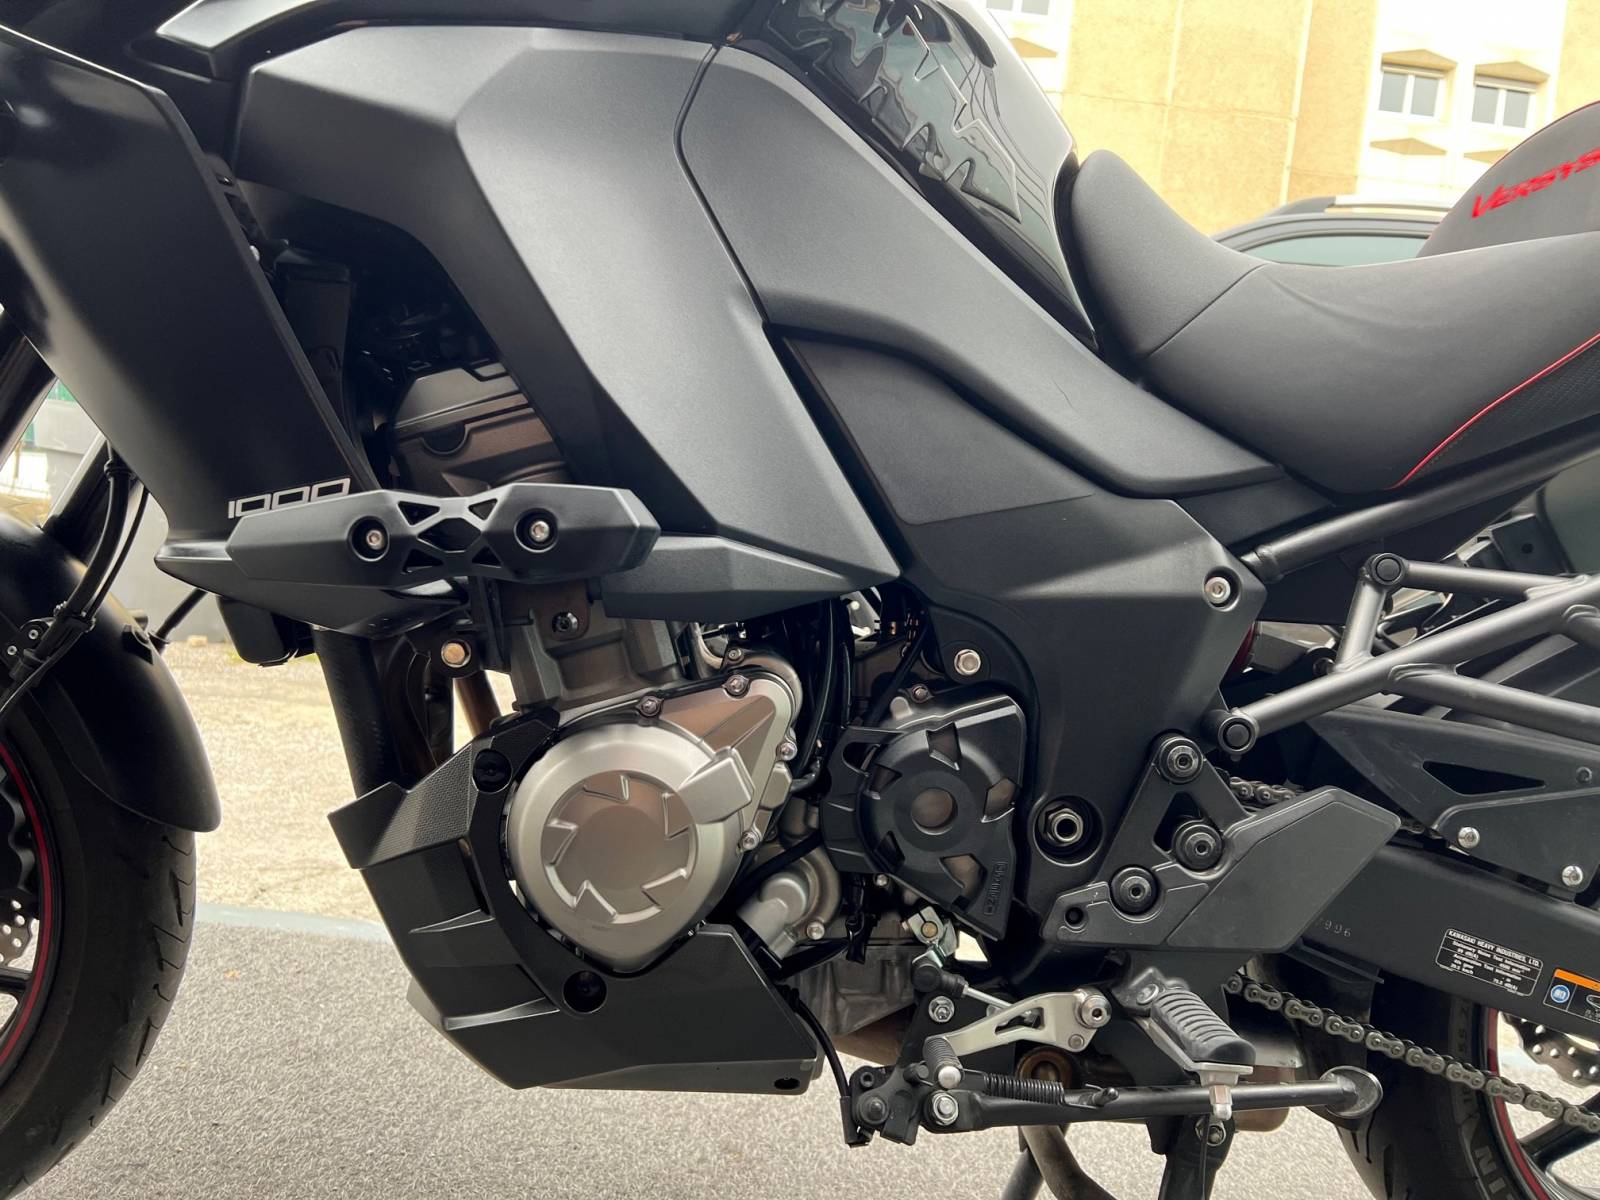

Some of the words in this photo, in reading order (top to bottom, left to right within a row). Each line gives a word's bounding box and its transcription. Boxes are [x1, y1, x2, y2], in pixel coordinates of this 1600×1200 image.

[228, 477, 350, 519] 1000
[1448, 930, 1476, 944] KAWASAKI
[1477, 939, 1495, 951] HEAVY
